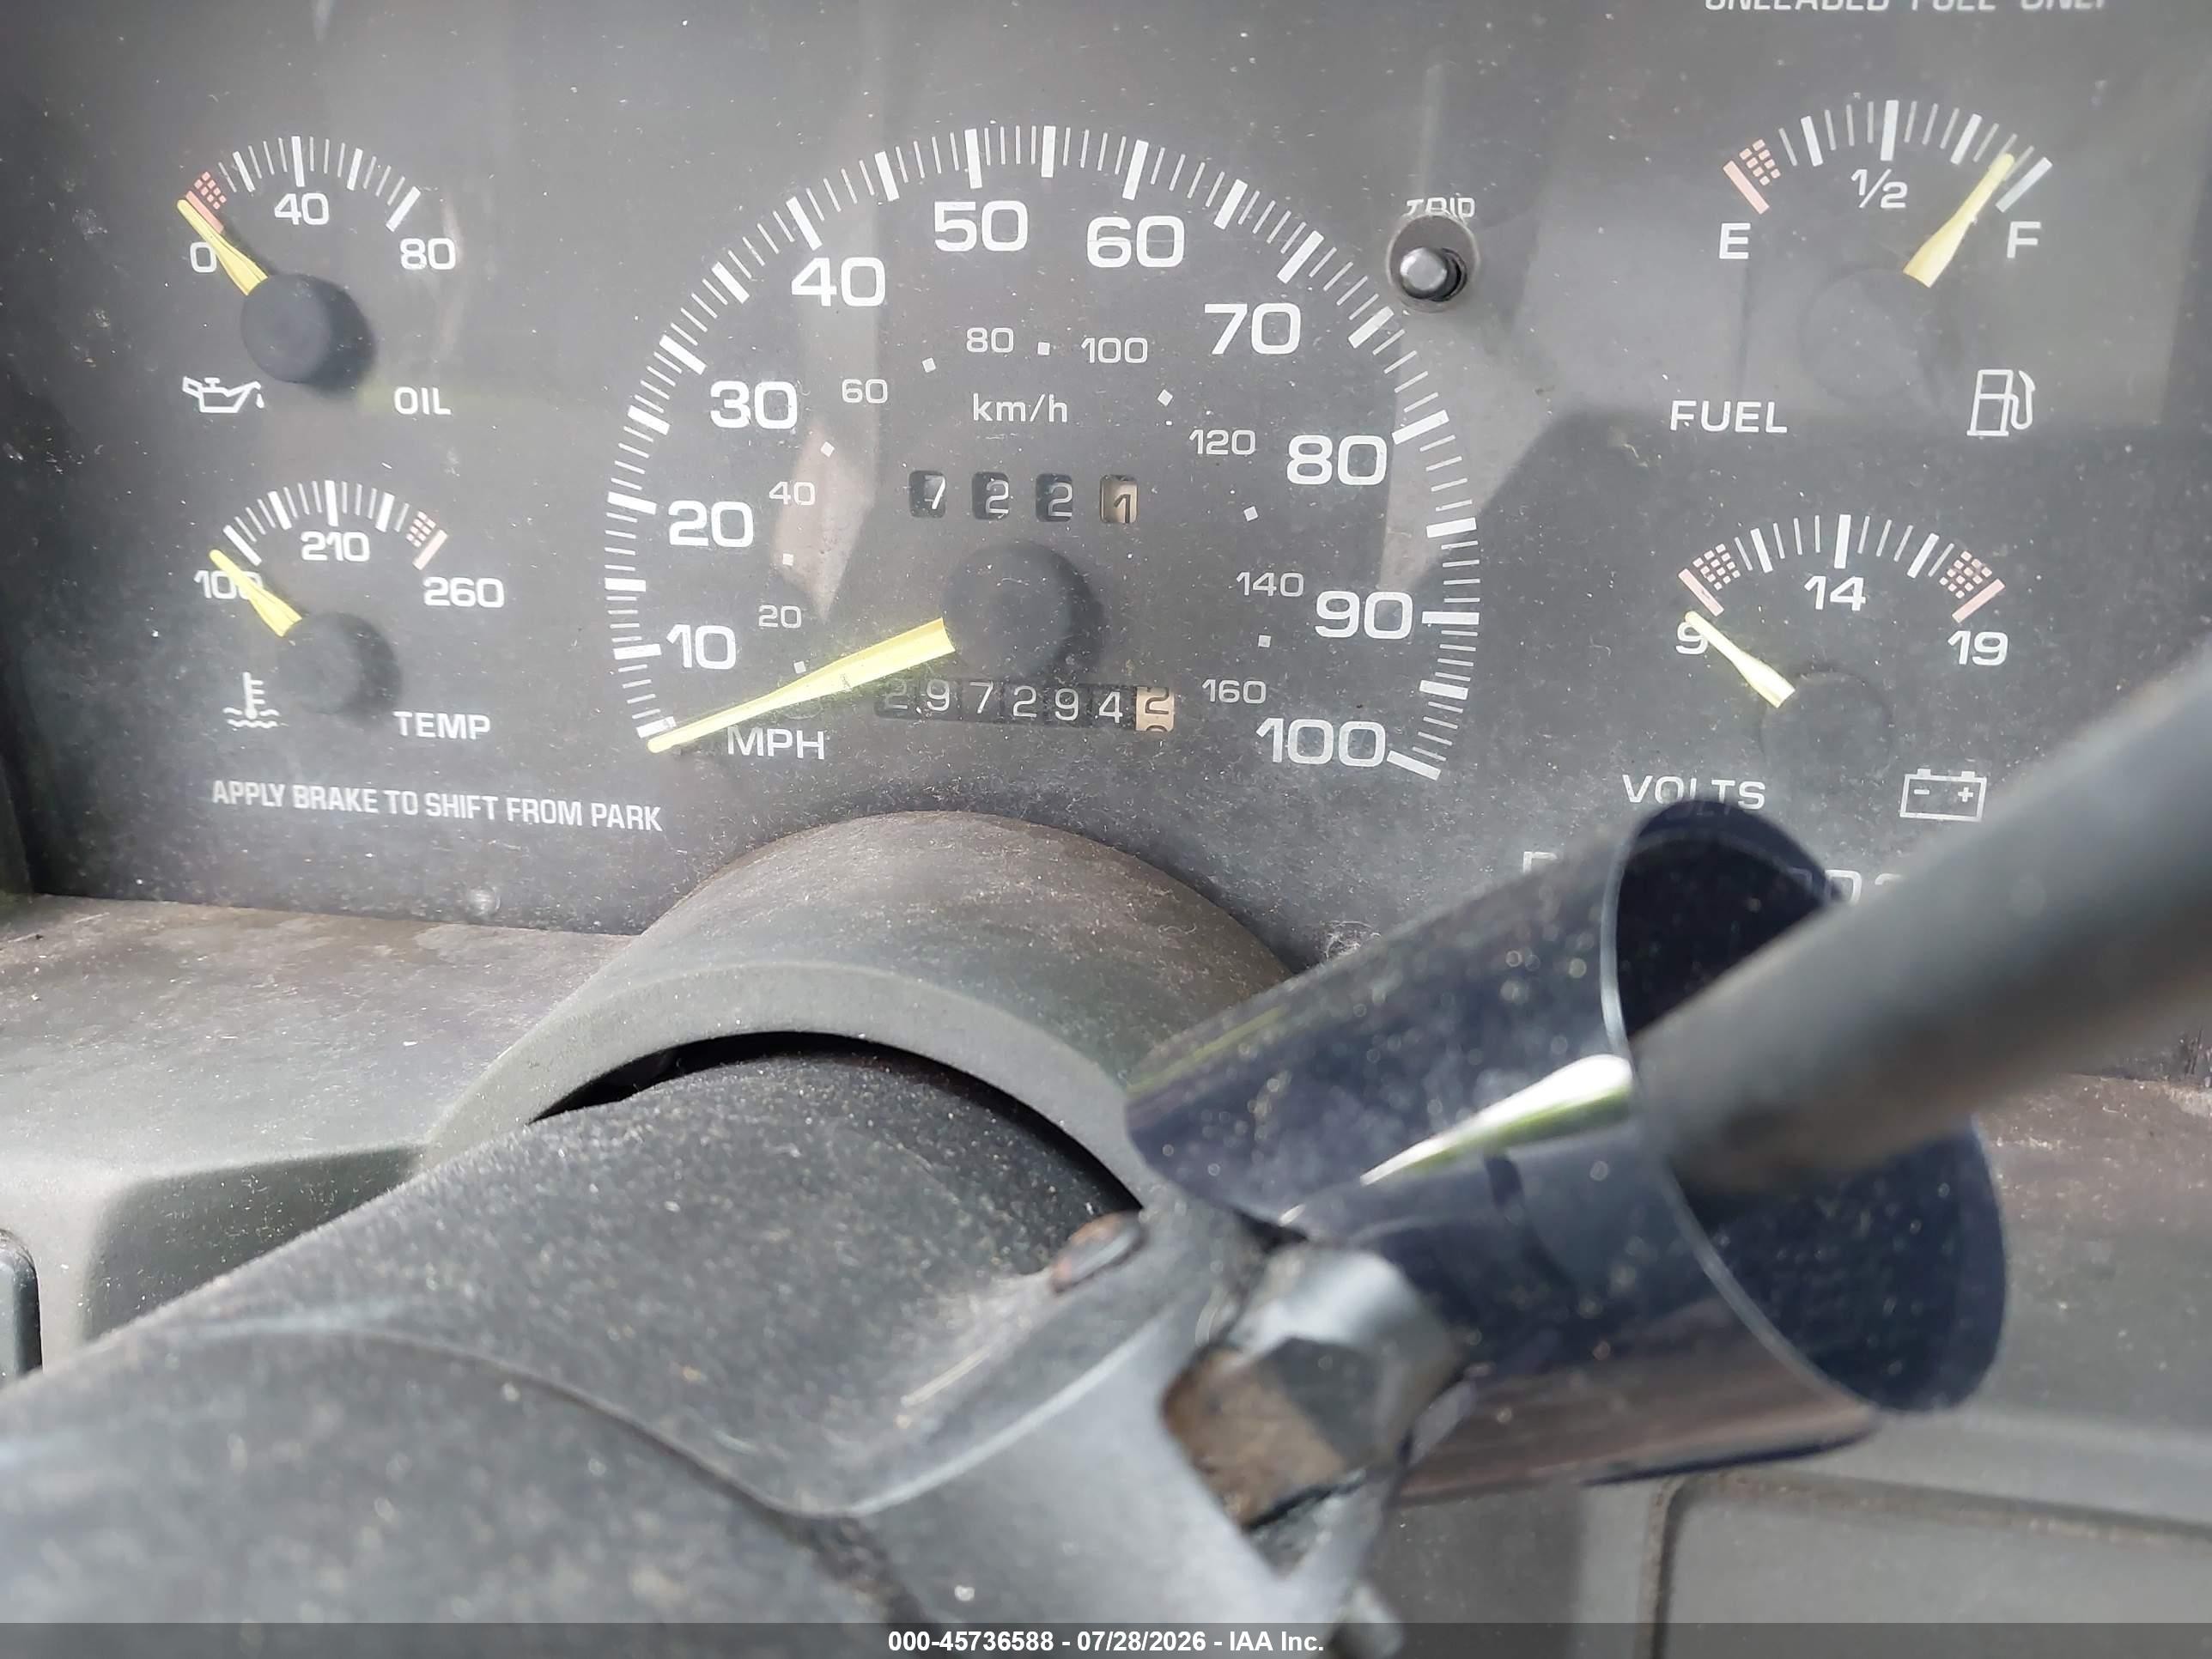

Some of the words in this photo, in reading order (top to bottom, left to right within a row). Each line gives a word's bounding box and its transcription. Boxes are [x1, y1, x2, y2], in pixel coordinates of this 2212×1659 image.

[274, 192, 329, 225] 40
[934, 200, 1028, 252] 50
[1087, 216, 1185, 267] 60
[1719, 222, 1751, 259] E
[2007, 221, 2041, 258] F
[190, 241, 217, 273] 0
[400, 238, 456, 270] 80
[791, 258, 885, 307] 40
[966, 328, 1014, 353] 80
[1205, 303, 1301, 355] 70
[1081, 337, 1148, 363] 100
[394, 386, 452, 415] OIL
[710, 380, 798, 428] 30
[842, 379, 888, 404] 60
[973, 393, 1067, 422] km/h
[1669, 400, 1788, 433] FUEL
[1189, 429, 1255, 455] 120
[1287, 434, 1387, 485] 80
[769, 482, 815, 505] 40
[668, 500, 754, 547] 20
[301, 531, 370, 562] 210
[423, 577, 504, 608] 260
[1237, 572, 1304, 597] 140
[1804, 575, 1866, 611] 14
[758, 605, 803, 629] 20
[1315, 591, 1413, 639] 90
[665, 624, 736, 670] 10
[1676, 621, 1709, 654] 9
[1947, 630, 2008, 665] 19
[1202, 678, 1267, 704] 160
[393, 710, 491, 740] TEMP
[727, 727, 824, 759] MPH
[1256, 718, 1386, 767] 100
[211, 779, 286, 808] APPLY
[293, 785, 379, 814] BRAKE
[385, 790, 418, 816] TO
[426, 792, 498, 821] SHIFT
[506, 798, 583, 826] FROM
[591, 805, 664, 832] PARK
